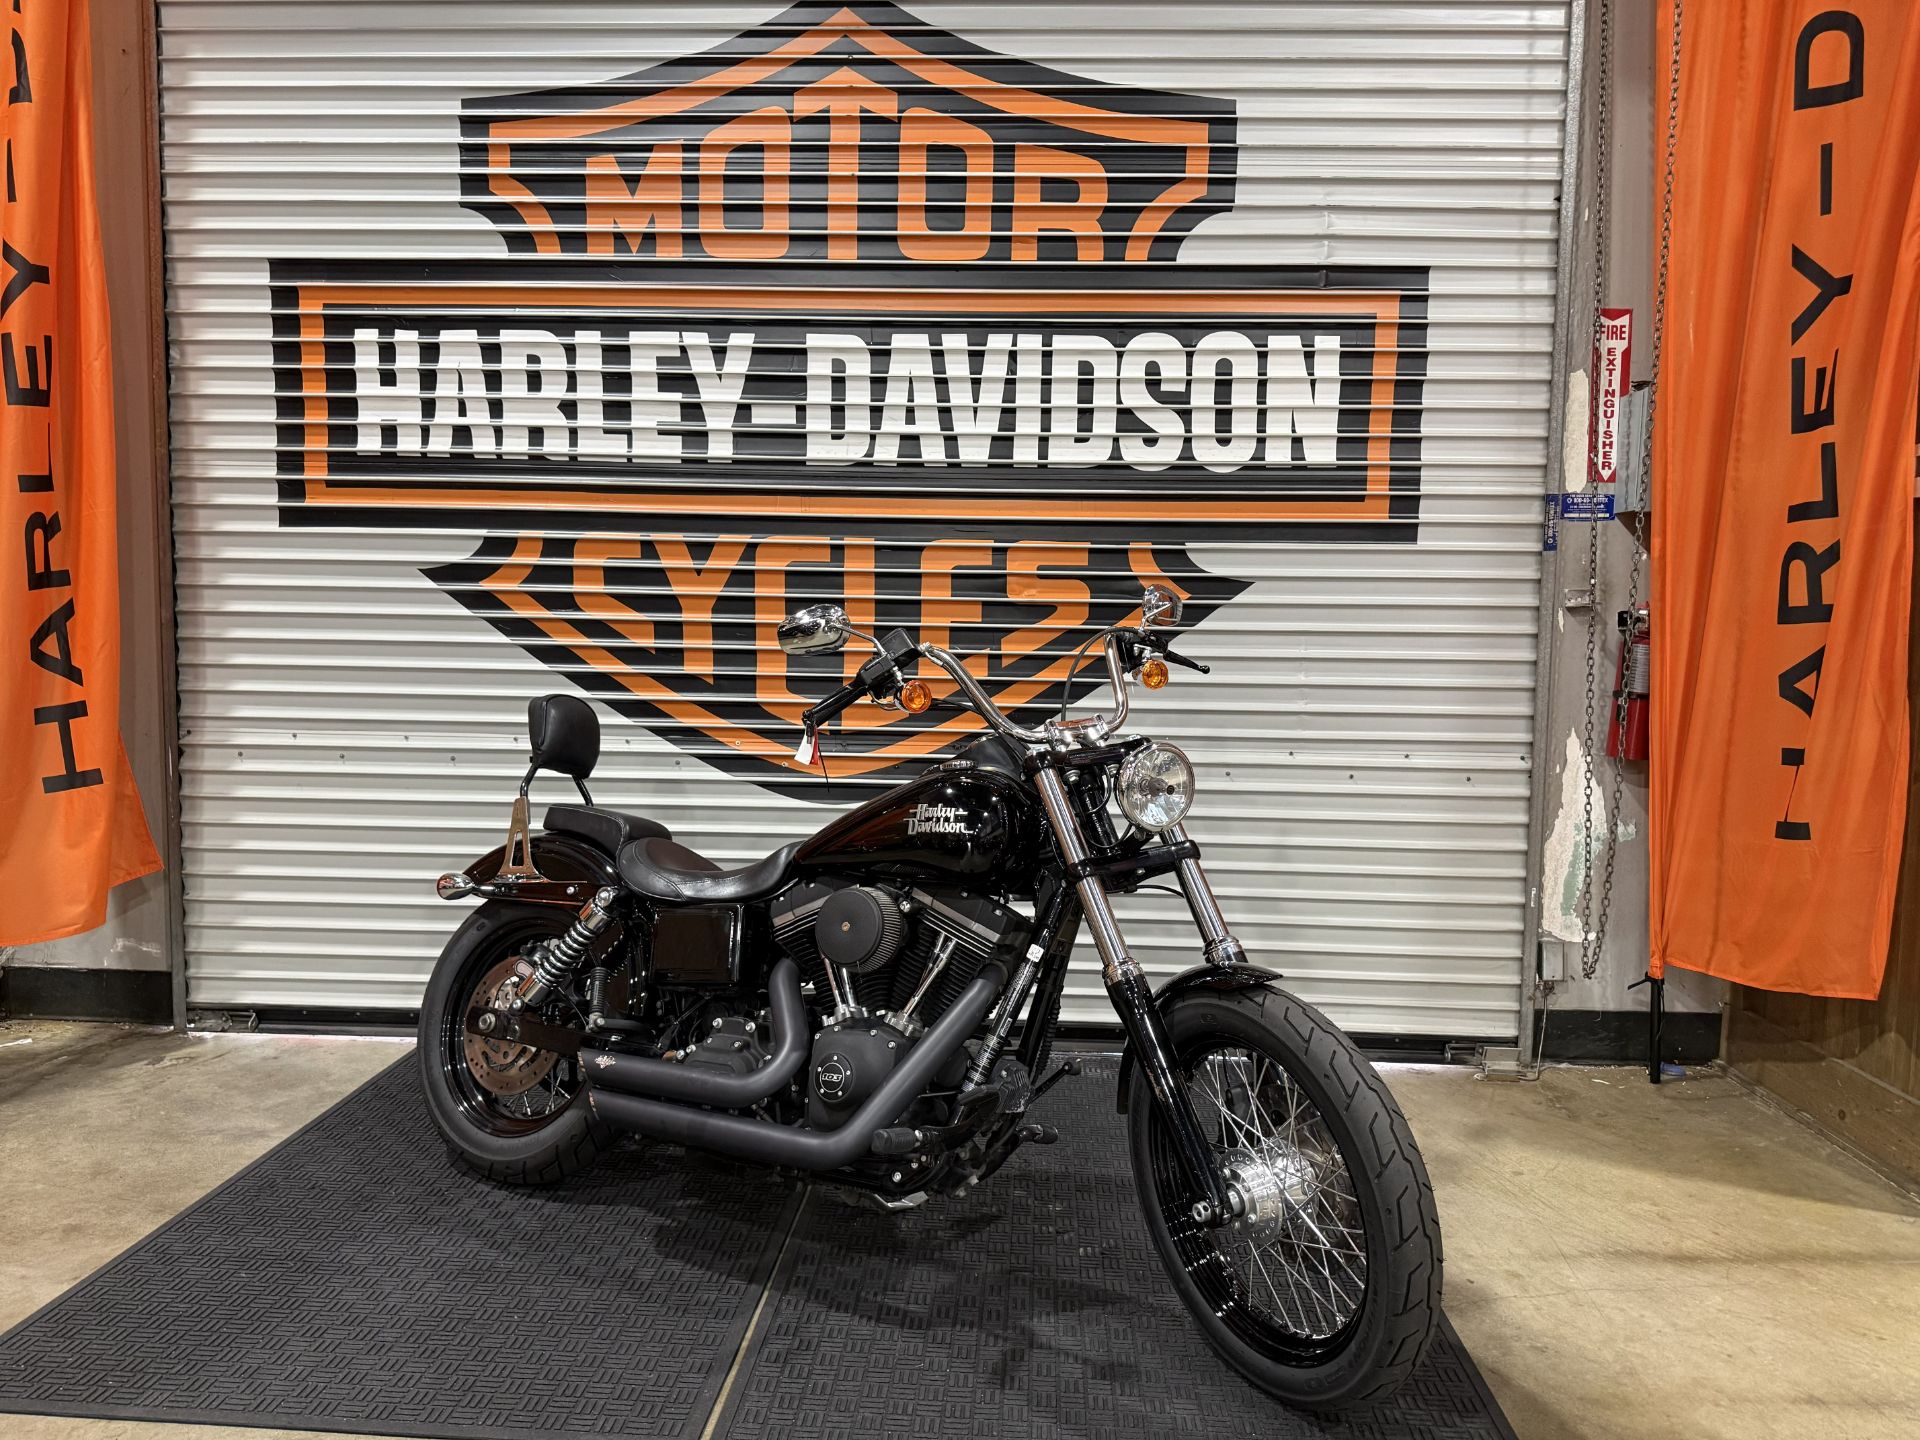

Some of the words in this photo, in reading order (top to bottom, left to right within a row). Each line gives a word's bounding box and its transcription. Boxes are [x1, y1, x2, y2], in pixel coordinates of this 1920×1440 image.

[585, 66, 1110, 263] MOTOR
[353, 328, 1343, 473] HARLEY-DAVIDSON
[1601, 347, 1617, 471] EXTINGUISHER
[572, 533, 1091, 735] CYCLES
[903, 817, 974, 835] Davidson
[821, 1072, 843, 1082] 103
